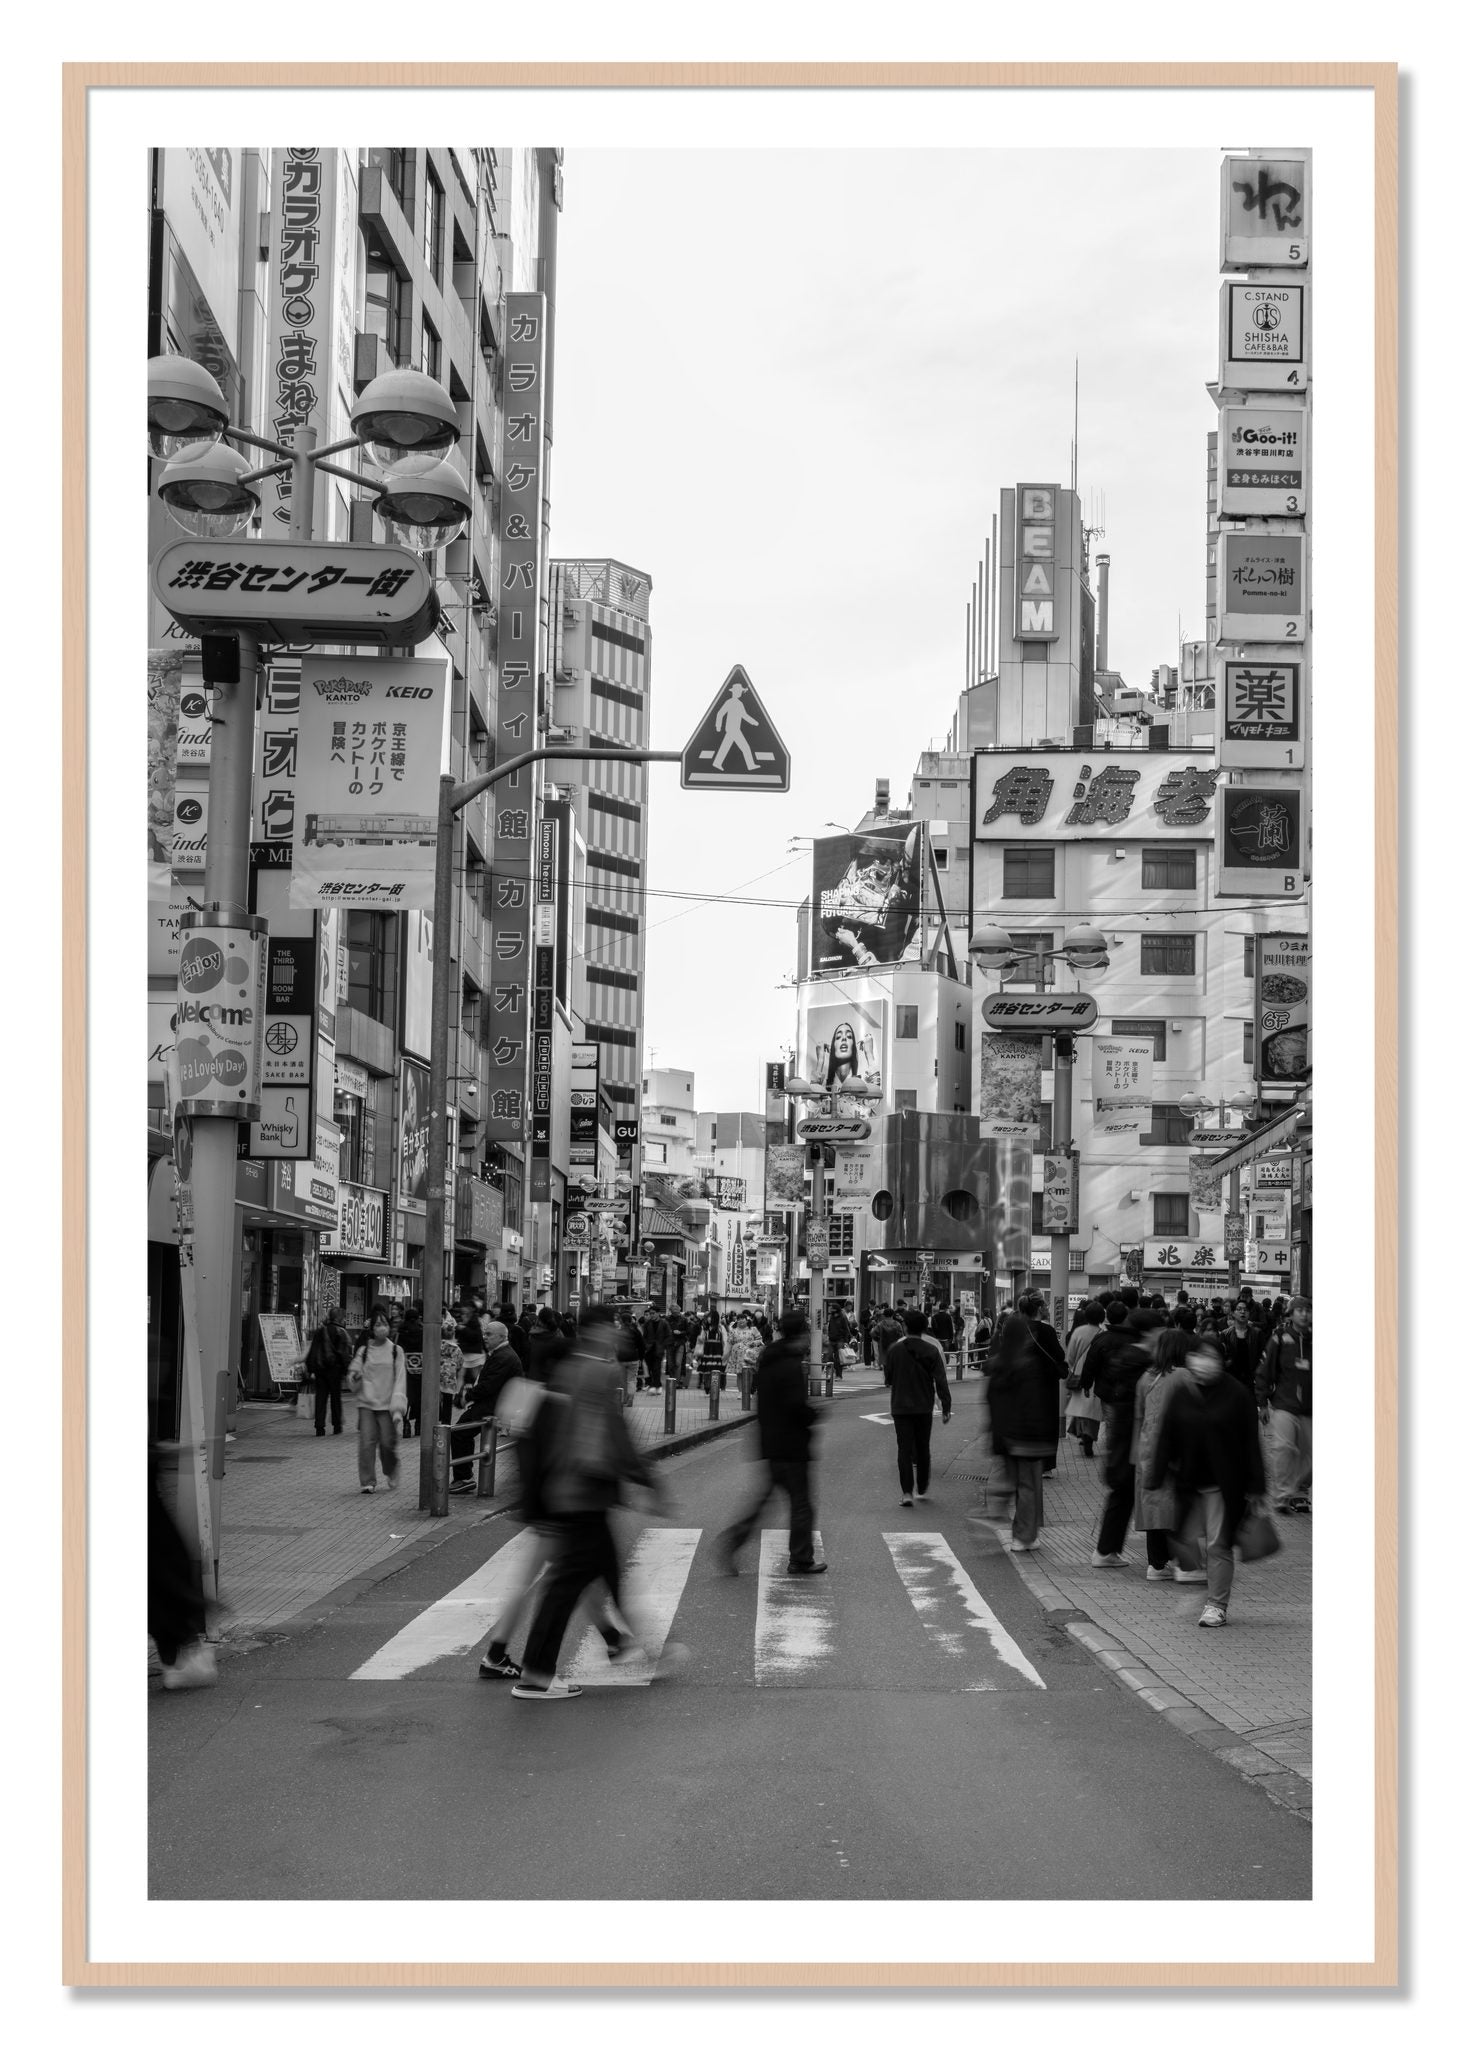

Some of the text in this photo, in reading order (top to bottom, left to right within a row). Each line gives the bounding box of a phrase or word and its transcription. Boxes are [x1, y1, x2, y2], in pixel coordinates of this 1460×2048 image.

[281, 161, 322, 299] カラオケ
[1289, 245, 1301, 260] 5
[1245, 292, 1289, 301] C.STAND
[1245, 332, 1288, 343] SHISHA
[1245, 343, 1288, 351] CAFE&BAR
[1287, 370, 1299, 385] 4
[1243, 428, 1297, 444] Goo-it!
[1236, 449, 1294, 457] 渋谷宇田川町店
[1231, 473, 1298, 484] 全身もみほぐし
[1286, 496, 1298, 512] 3
[1022, 488, 1055, 632] BEAM
[169, 560, 415, 598] 渋谷センター街
[1232, 567, 1295, 586] ポムの樹
[1286, 622, 1297, 637] 2
[386, 686, 433, 700] KEIO
[1235, 670, 1285, 720] 薬
[1230, 723, 1291, 738] マツモトキヨシ
[262, 643, 302, 840] ラオケ
[331, 721, 347, 764] 冒険へ
[182, 749, 206, 757] 渋谷店
[349, 721, 366, 795] カントーの
[369, 722, 387, 795] ポケパーク
[390, 722, 407, 781] 京王線で
[1285, 749, 1293, 764] 1
[983, 765, 1221, 825] 角海老
[1230, 804, 1289, 851] 一蘭
[543, 823, 551, 859] kimono
[177, 855, 202, 863] 渋谷店
[318, 882, 405, 896] 渋谷センター街
[1284, 876, 1296, 891] B
[820, 887, 860, 900] SHAPING
[1264, 954, 1308, 967] 四川料理
[181, 951, 221, 986] Enjoy
[275, 995, 290, 1003] BAR
[491, 879, 526, 1120] カラオケ館
[177, 1000, 253, 1025] Welcome
[989, 1002, 1091, 1015] 渋谷センター街
[1262, 1011, 1290, 1030] 6F
[194, 1058, 224, 1077] Lovely
[226, 1059, 245, 1072] Day!
[261, 1123, 293, 1134] Whisky
[617, 1127, 636, 1137] GU
[801, 1124, 862, 1133] 渋谷センター街
[734, 1243, 743, 1285] BEER
